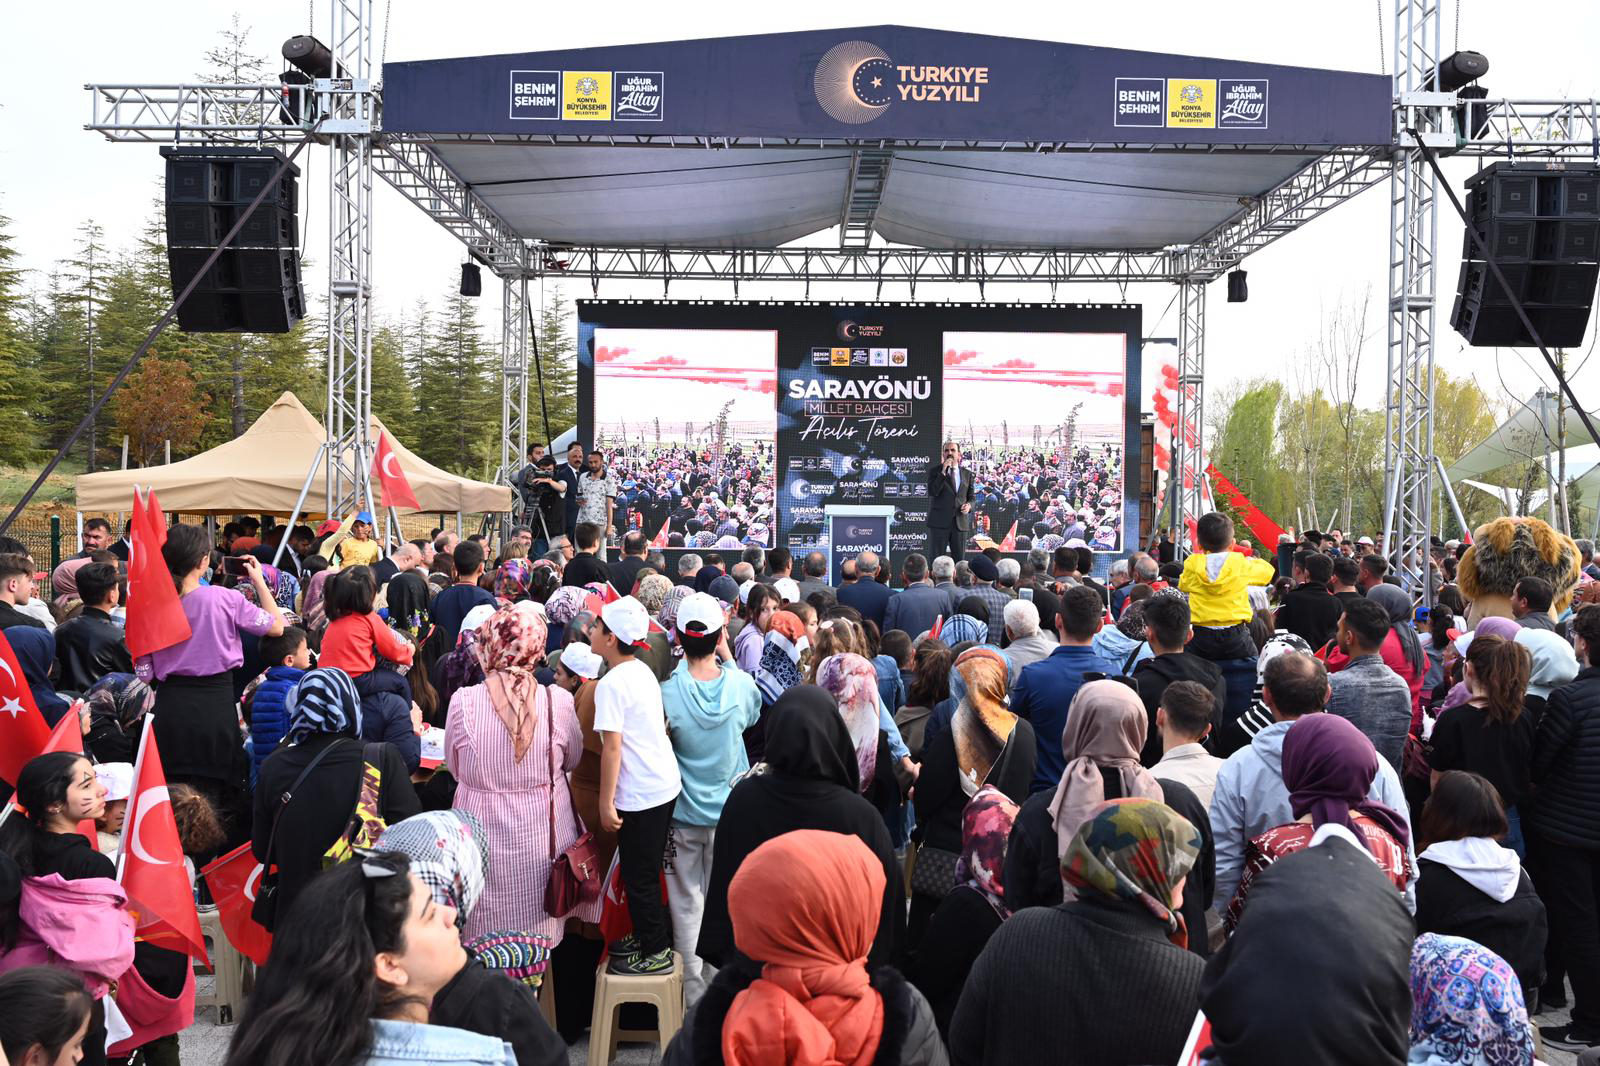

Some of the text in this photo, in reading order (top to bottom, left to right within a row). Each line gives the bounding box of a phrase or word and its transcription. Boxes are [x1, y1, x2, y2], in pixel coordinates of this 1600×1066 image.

[627, 76, 652, 85] UĞUR
[514, 83, 556, 95] BENİM
[1232, 84, 1257, 93] UĞUR
[514, 95, 556, 107] ŞEHRİM
[616, 91, 660, 113] Altay
[1119, 90, 1161, 102] BENİM
[1118, 103, 1161, 115] ŞEHRİM
[1221, 99, 1265, 121] Altay
[788, 374, 932, 400] SARAYÖNÜ
[798, 415, 919, 442] Açılış Töreni
[890, 455, 930, 464] SARAYÖNÜ
[835, 543, 883, 553] SARAYÖNÜ
